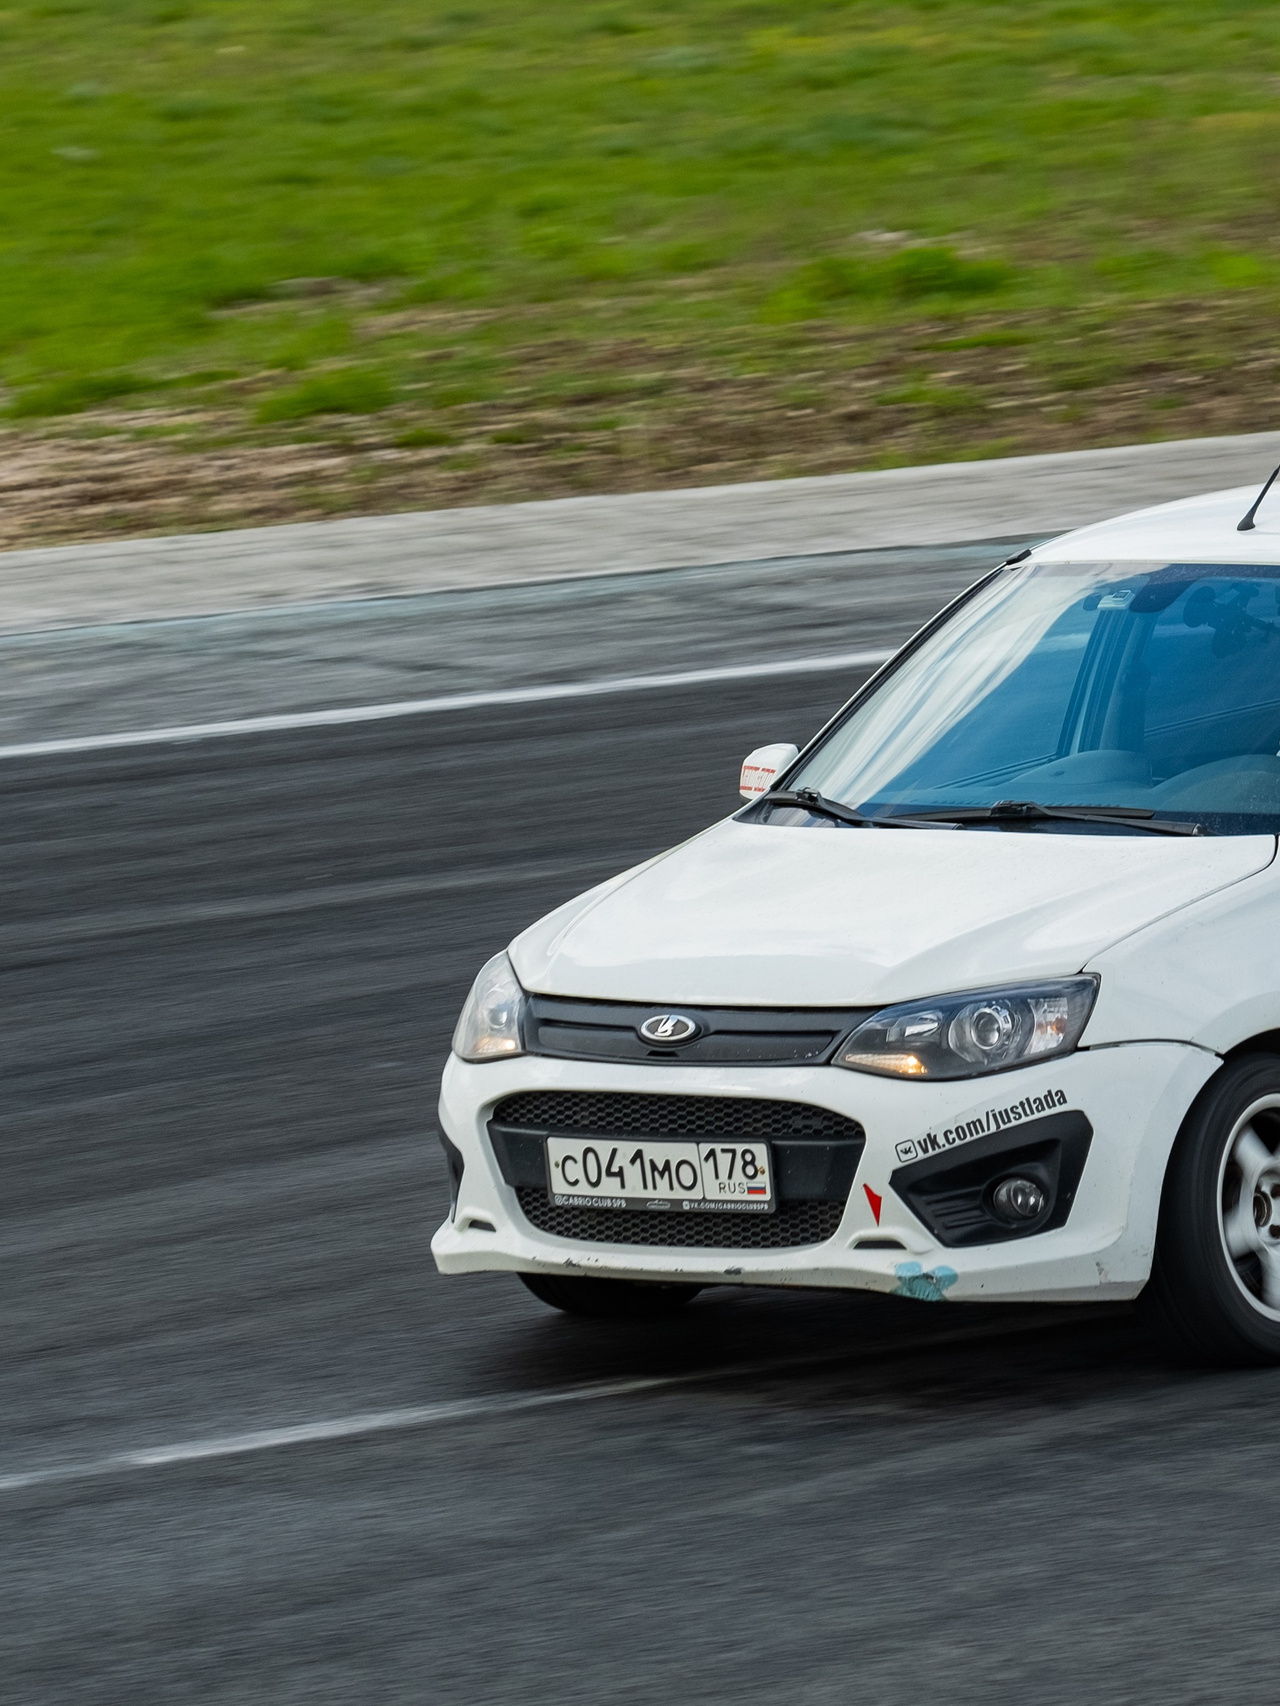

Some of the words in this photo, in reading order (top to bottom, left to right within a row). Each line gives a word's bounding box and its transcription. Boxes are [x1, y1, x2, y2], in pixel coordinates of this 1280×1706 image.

[916, 1088, 1068, 1154] vk.com/justlada
[704, 1147, 759, 1181] 178
[718, 1182, 746, 1194] RUS
